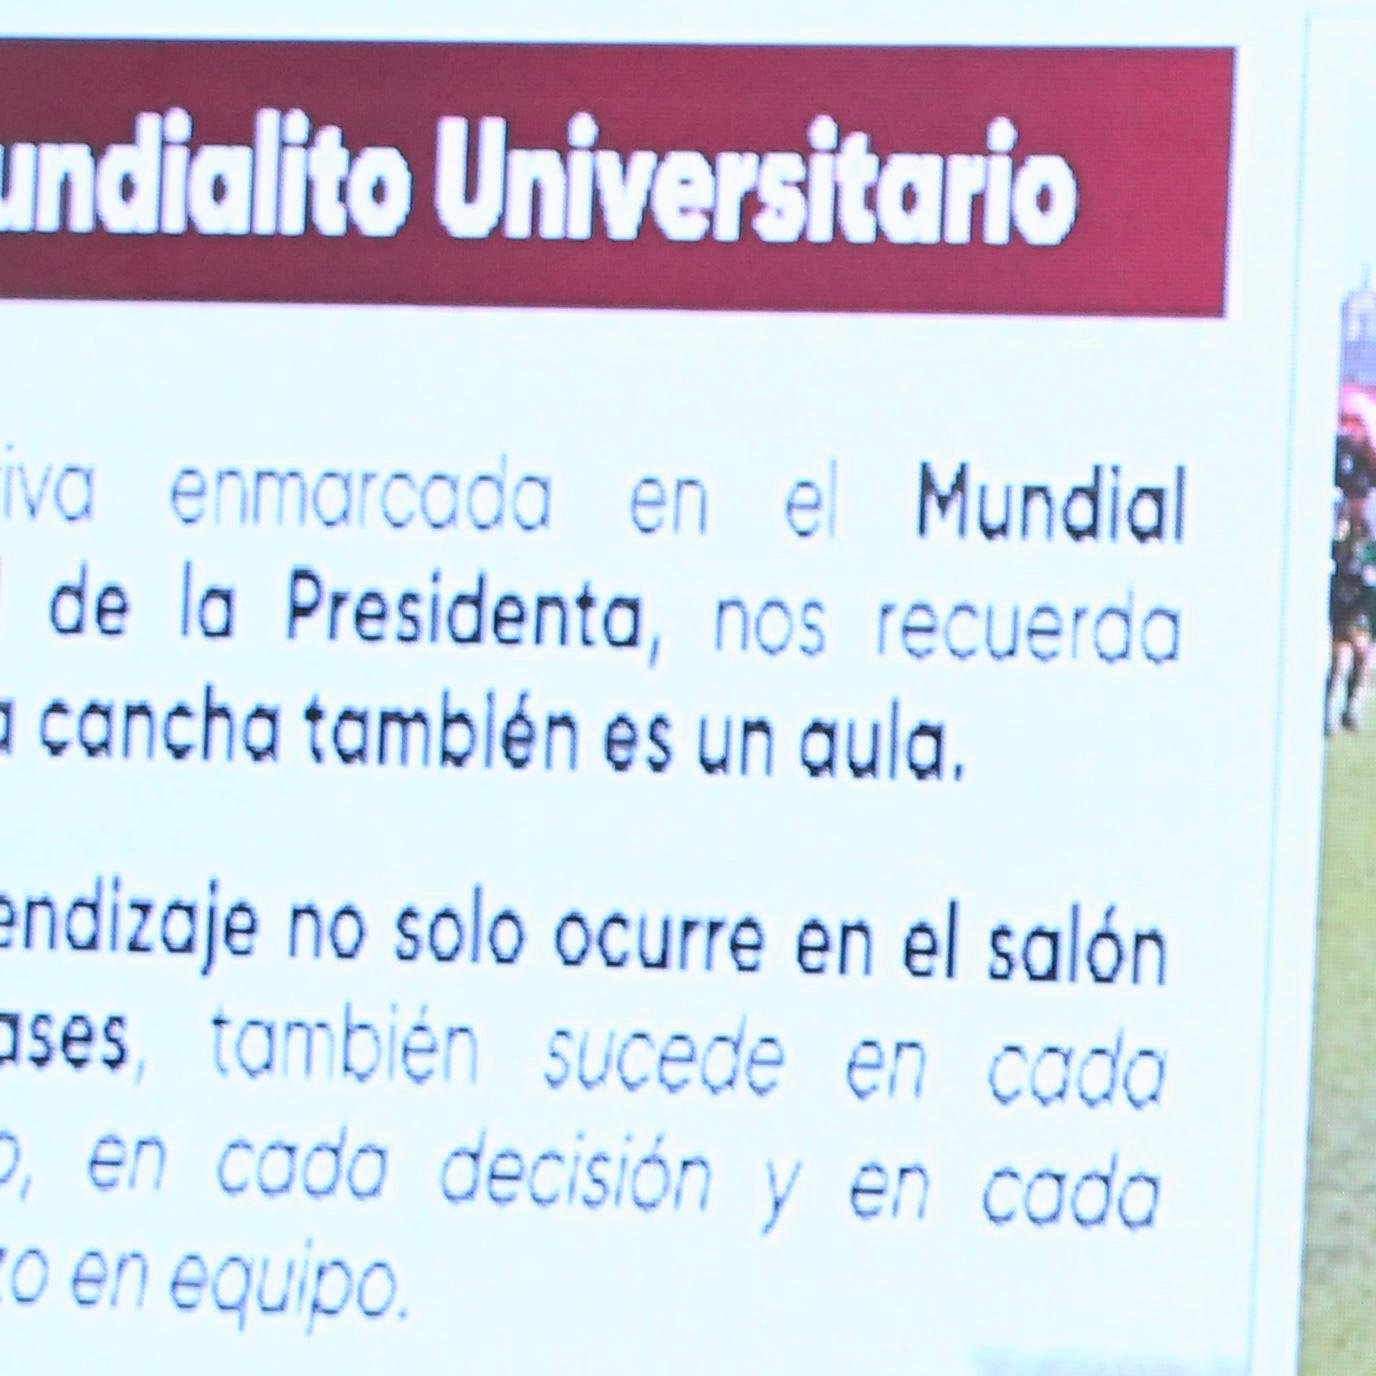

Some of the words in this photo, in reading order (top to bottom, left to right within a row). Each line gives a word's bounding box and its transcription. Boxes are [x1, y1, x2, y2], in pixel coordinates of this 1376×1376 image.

[434, 112, 1078, 247] Universitario
[168, 453, 552, 533] enmarcada
[628, 474, 707, 535] en
[783, 458, 837, 539] el
[914, 458, 1187, 545] Mundial
[46, 559, 131, 638] de
[179, 558, 236, 640] la
[284, 562, 661, 669] Presidenta,
[713, 594, 826, 658] nos
[876, 589, 1181, 666] recuerda
[37, 679, 281, 765] cancha
[300, 686, 579, 772] también
[601, 709, 674, 775] es
[696, 713, 775, 777] un
[798, 695, 965, 782] aula.
[286, 898, 367, 961] no
[392, 880, 527, 966] solo
[551, 906, 766, 974] ocurre
[793, 913, 874, 977] en
[900, 895, 960, 980] el
[986, 899, 1168, 987] salón
[208, 999, 478, 1086] también
[542, 1014, 785, 1098] sucede
[844, 1037, 927, 1102] en
[986, 1030, 1166, 1111] cada
[85, 1131, 167, 1192] en
[214, 1124, 389, 1202] cada
[438, 1129, 712, 1213] decisión
[760, 1160, 802, 1235] y
[848, 1159, 930, 1221] en
[980, 1150, 1161, 1232] cada
[68, 1246, 149, 1309] en
[167, 1237, 407, 1335] equipo.
